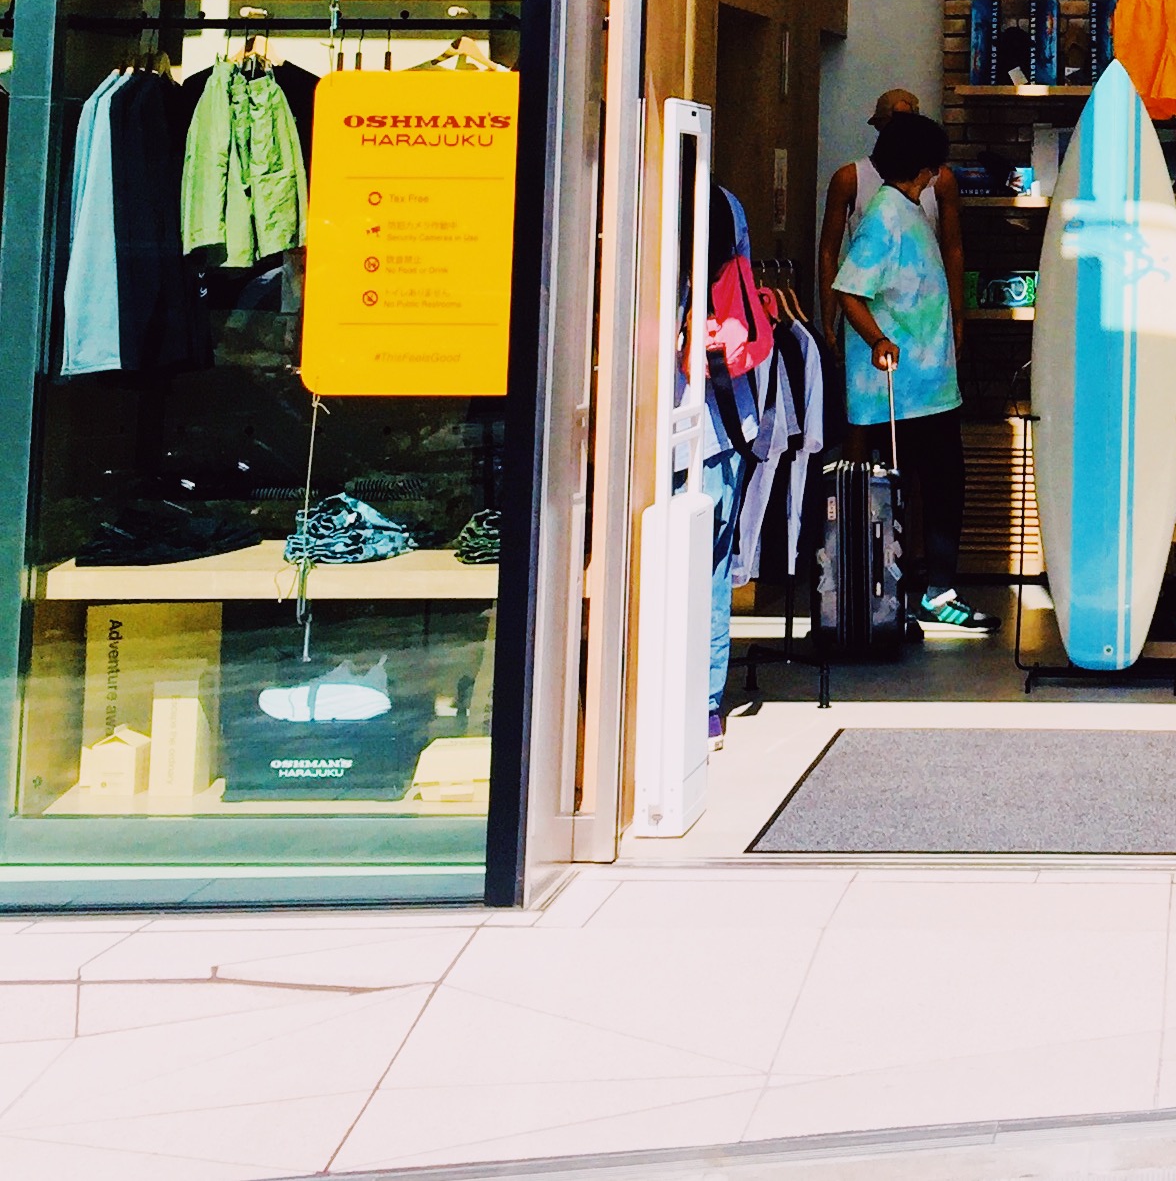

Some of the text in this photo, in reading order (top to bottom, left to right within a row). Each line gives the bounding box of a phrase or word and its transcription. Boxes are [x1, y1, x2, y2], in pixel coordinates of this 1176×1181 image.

[343, 112, 512, 129] OSHMAN'S
[361, 134, 494, 147] HARAJUKU
[389, 193, 430, 203] Tax Free
[106, 618, 123, 701] Adventure
[270, 758, 354, 769] OSHMAN'S
[278, 769, 345, 778] HARAJUKU
